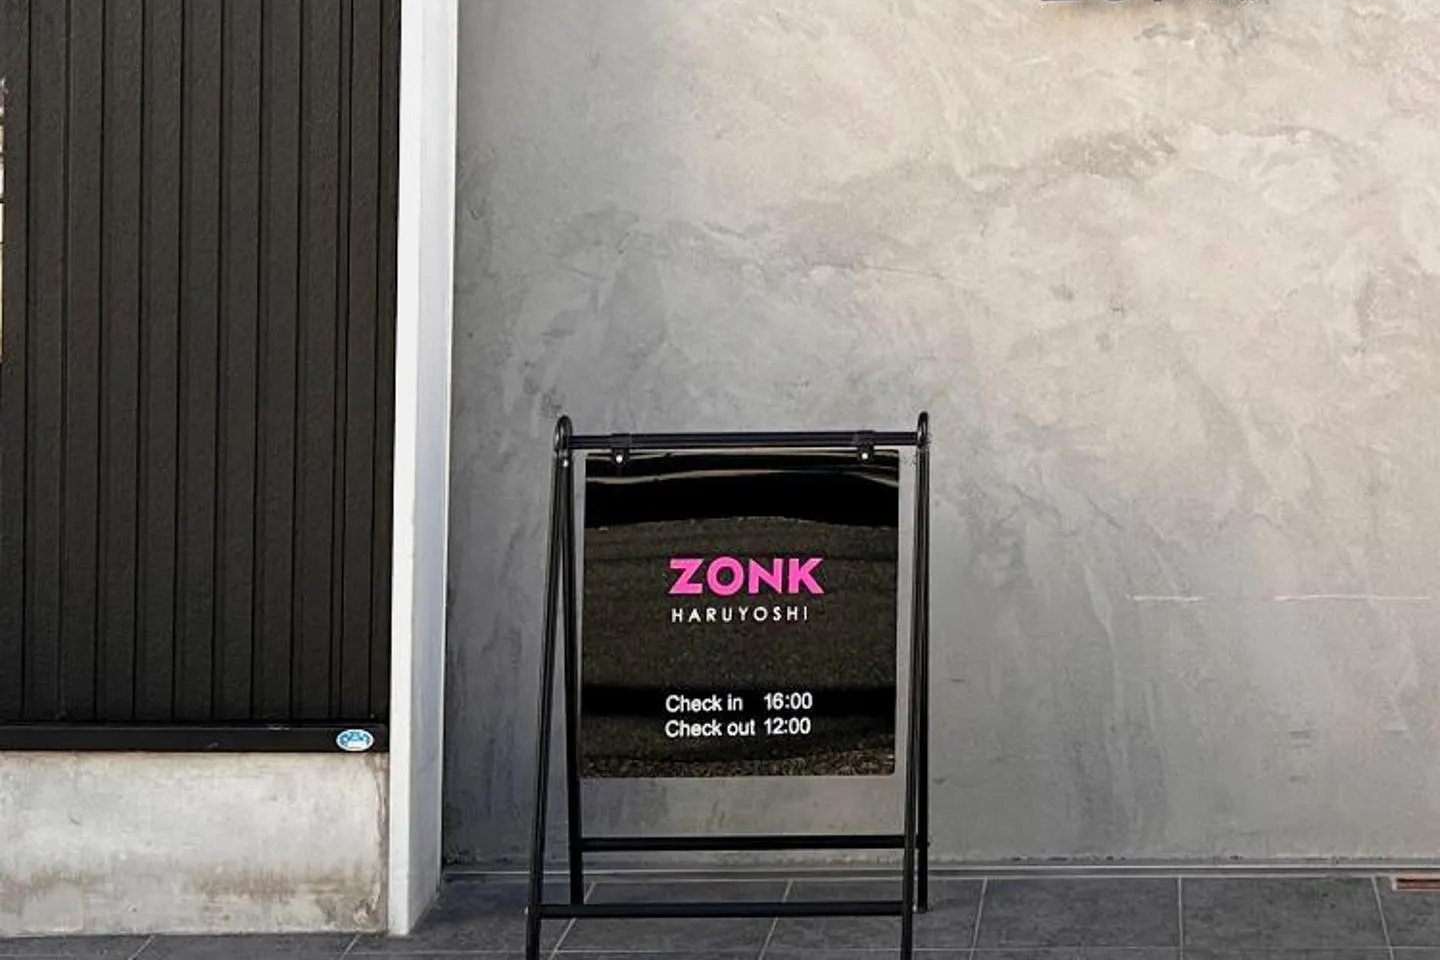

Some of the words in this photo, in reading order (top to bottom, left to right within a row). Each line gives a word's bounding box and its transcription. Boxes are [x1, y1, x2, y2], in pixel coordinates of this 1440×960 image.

[668, 556, 825, 596] ZONK
[671, 606, 808, 623] HARUYOSHI
[665, 694, 722, 713] Check
[727, 693, 743, 711] in
[763, 692, 813, 710] 16:00
[664, 719, 722, 738] Check
[727, 719, 755, 736] out
[763, 717, 811, 735] 12:00
